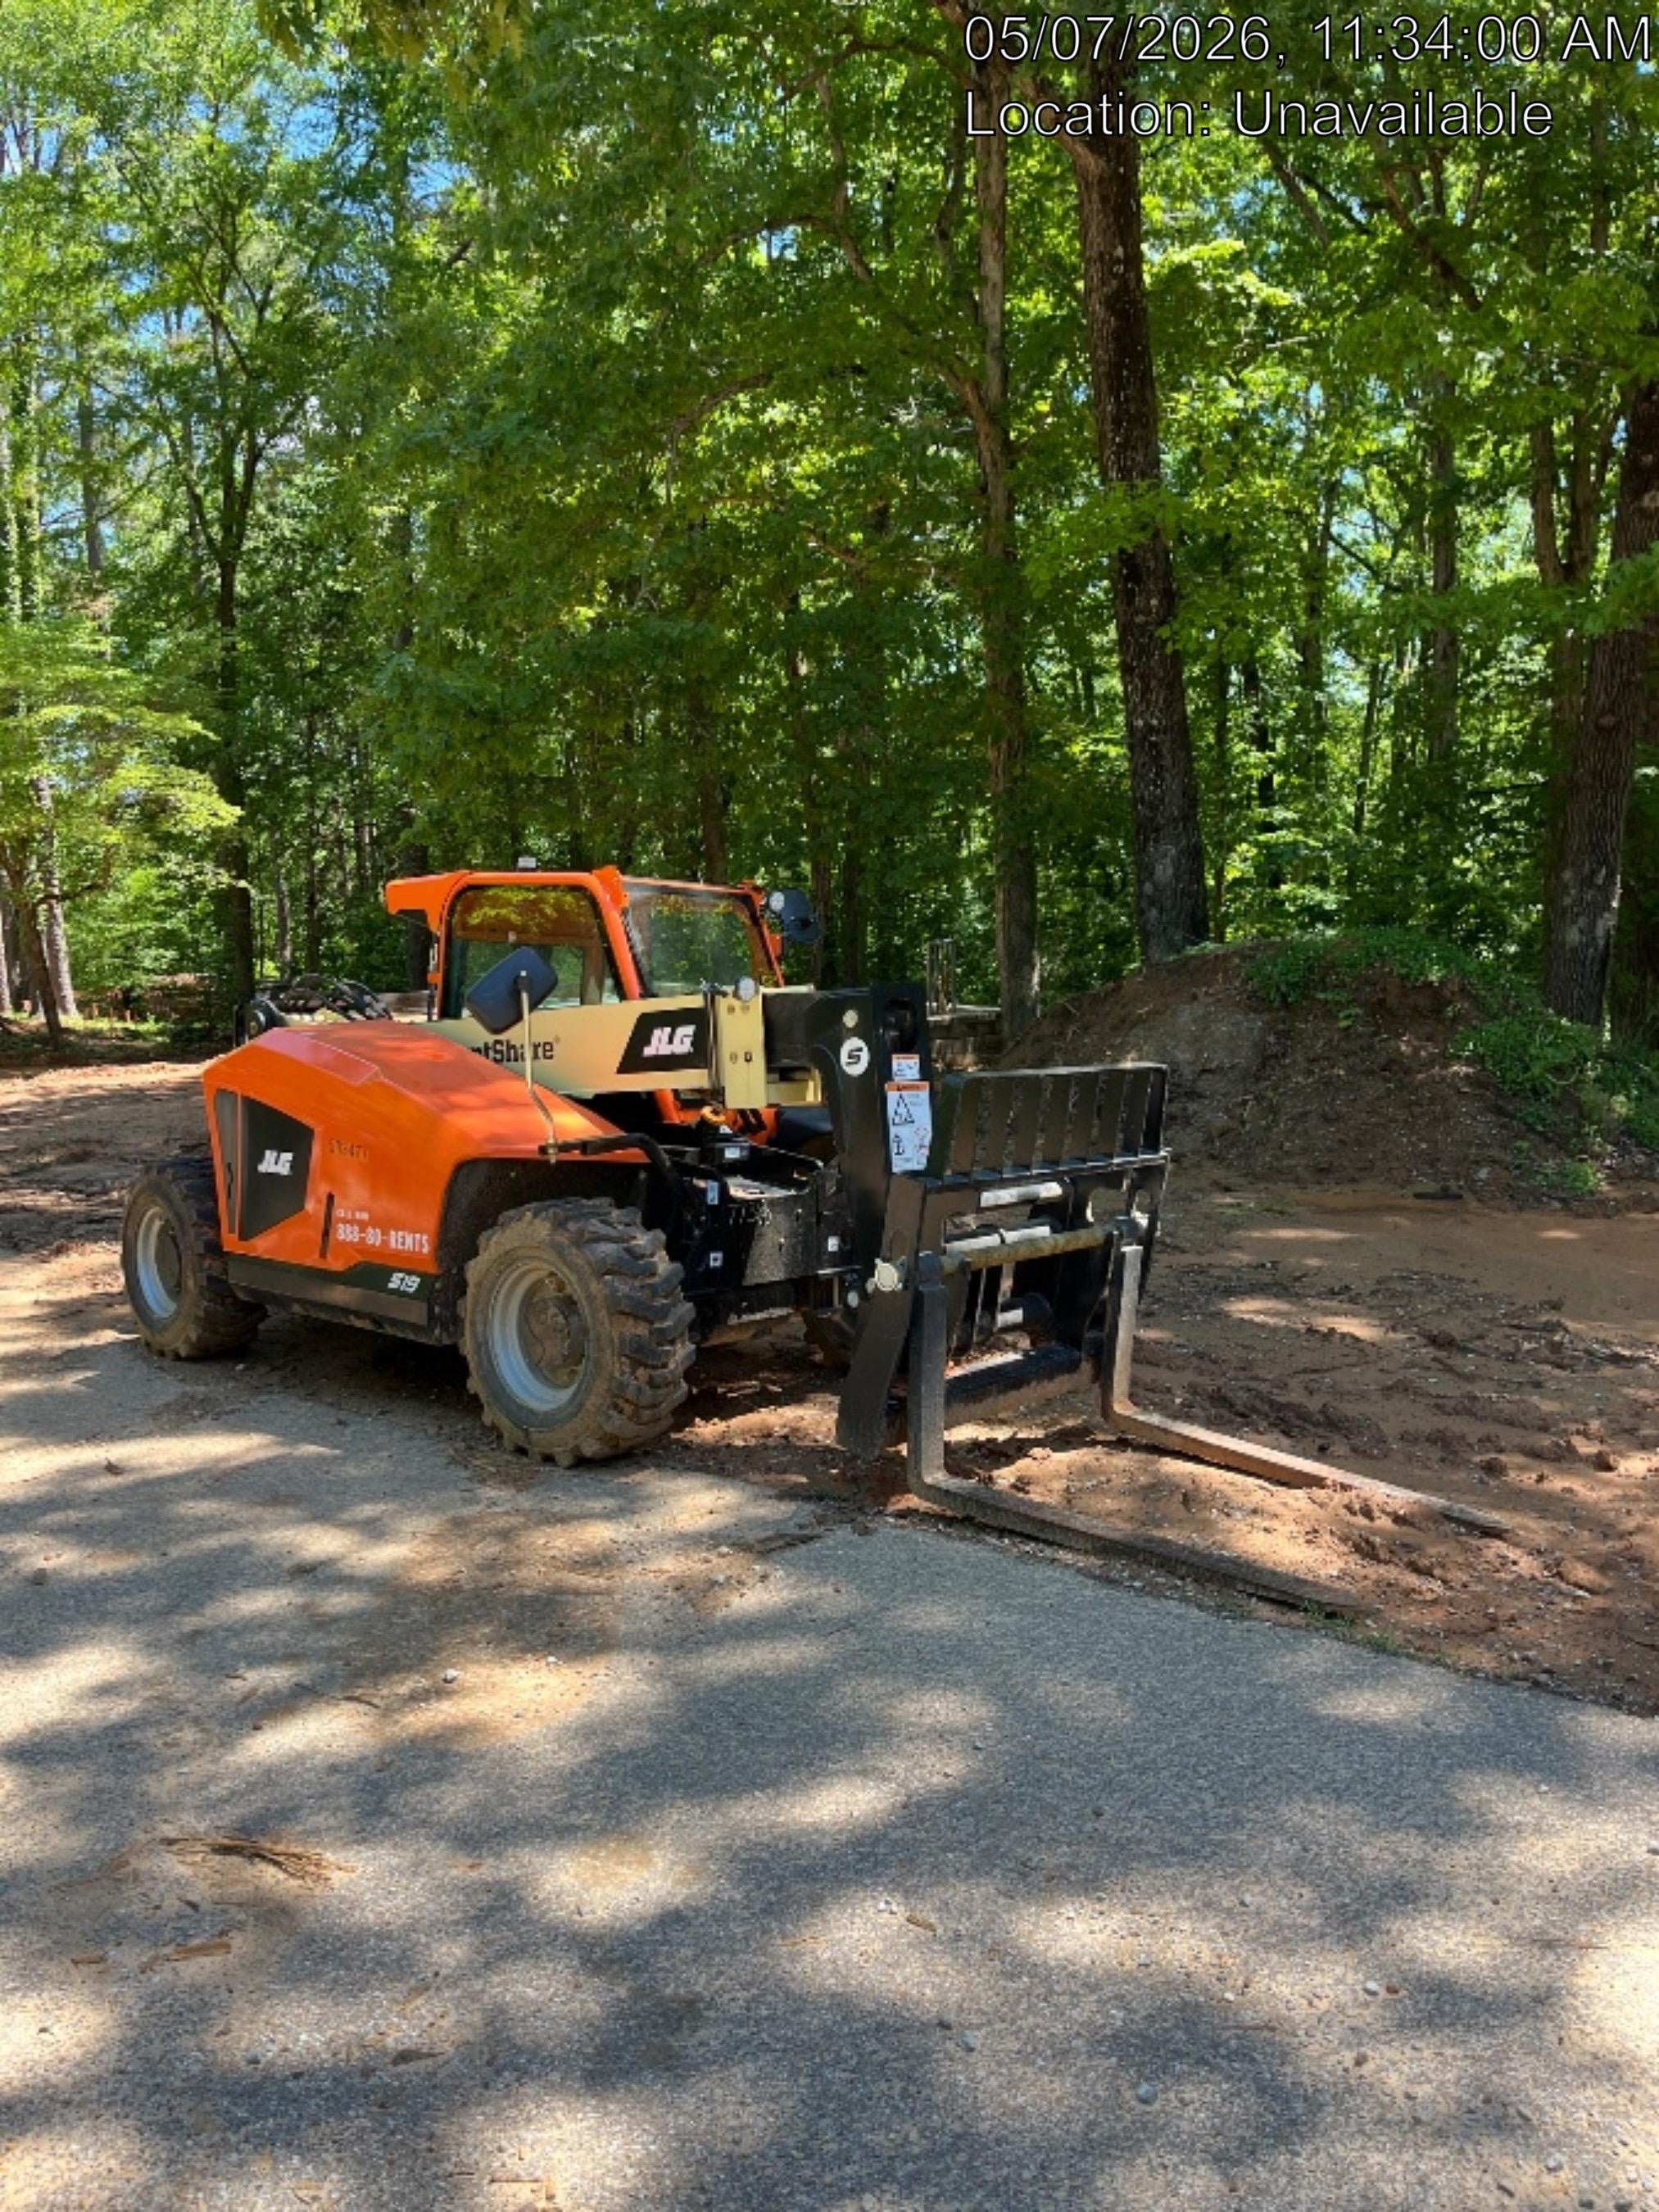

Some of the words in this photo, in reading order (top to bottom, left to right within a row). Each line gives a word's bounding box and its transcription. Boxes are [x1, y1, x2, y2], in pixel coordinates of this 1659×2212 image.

[643, 1024, 696, 1056] JLG
[257, 1149, 292, 1175] JLG
[388, 1272, 420, 1293] S19
